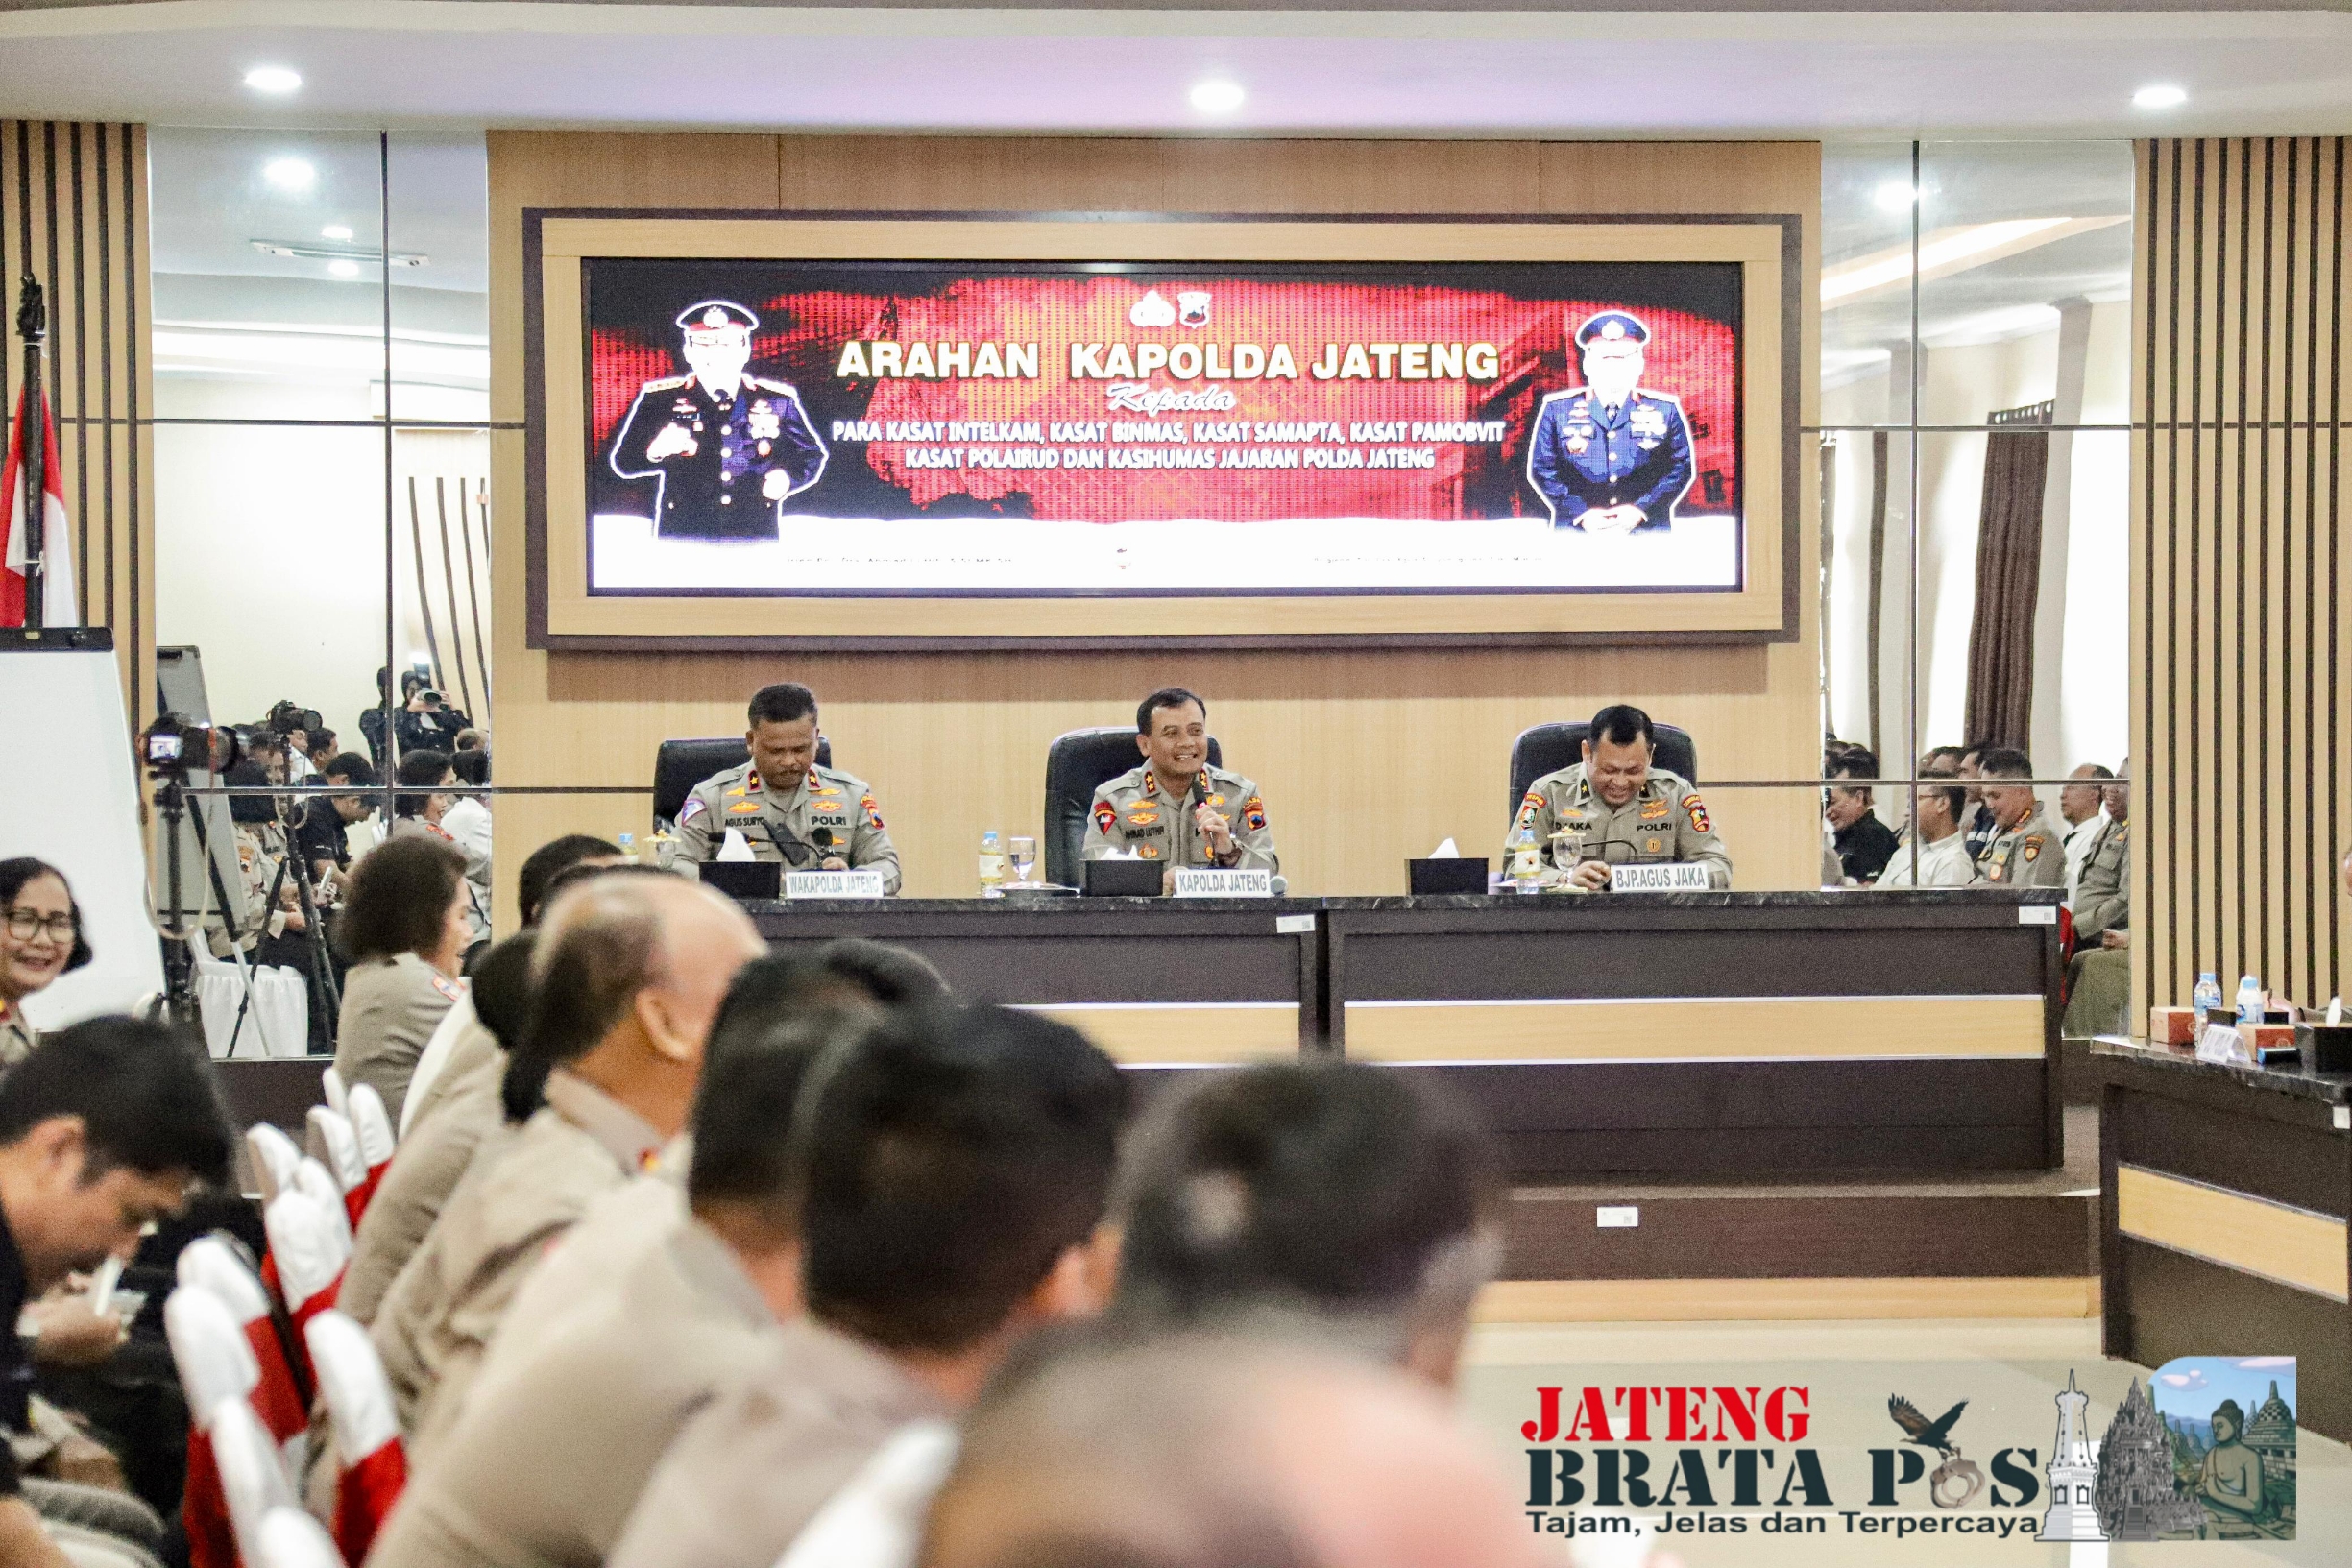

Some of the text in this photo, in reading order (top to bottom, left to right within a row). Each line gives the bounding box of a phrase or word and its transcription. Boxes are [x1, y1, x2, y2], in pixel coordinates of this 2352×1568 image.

[837, 341, 1499, 380] ARAHAN KAPOLDA JATENG
[1107, 383, 1236, 417] Kepada
[833, 421, 1506, 445] PARA KASAT INTELKAM, KASAT BINMAS, KASAT SAMAPTA, KASAT PAMOBVIT
[906, 448, 1435, 469] KASAT POLAIRUD DAN KASIHUMAS JAJARAN POLDA JATENG
[811, 816, 846, 826] POLRI
[1637, 823, 1672, 832] POLRI
[789, 875, 879, 893] WAKAPOLDA JATENG
[1178, 874, 1267, 892] KAPOLDA JATENG
[1615, 867, 1705, 888] BJP.AGUS JAKA
